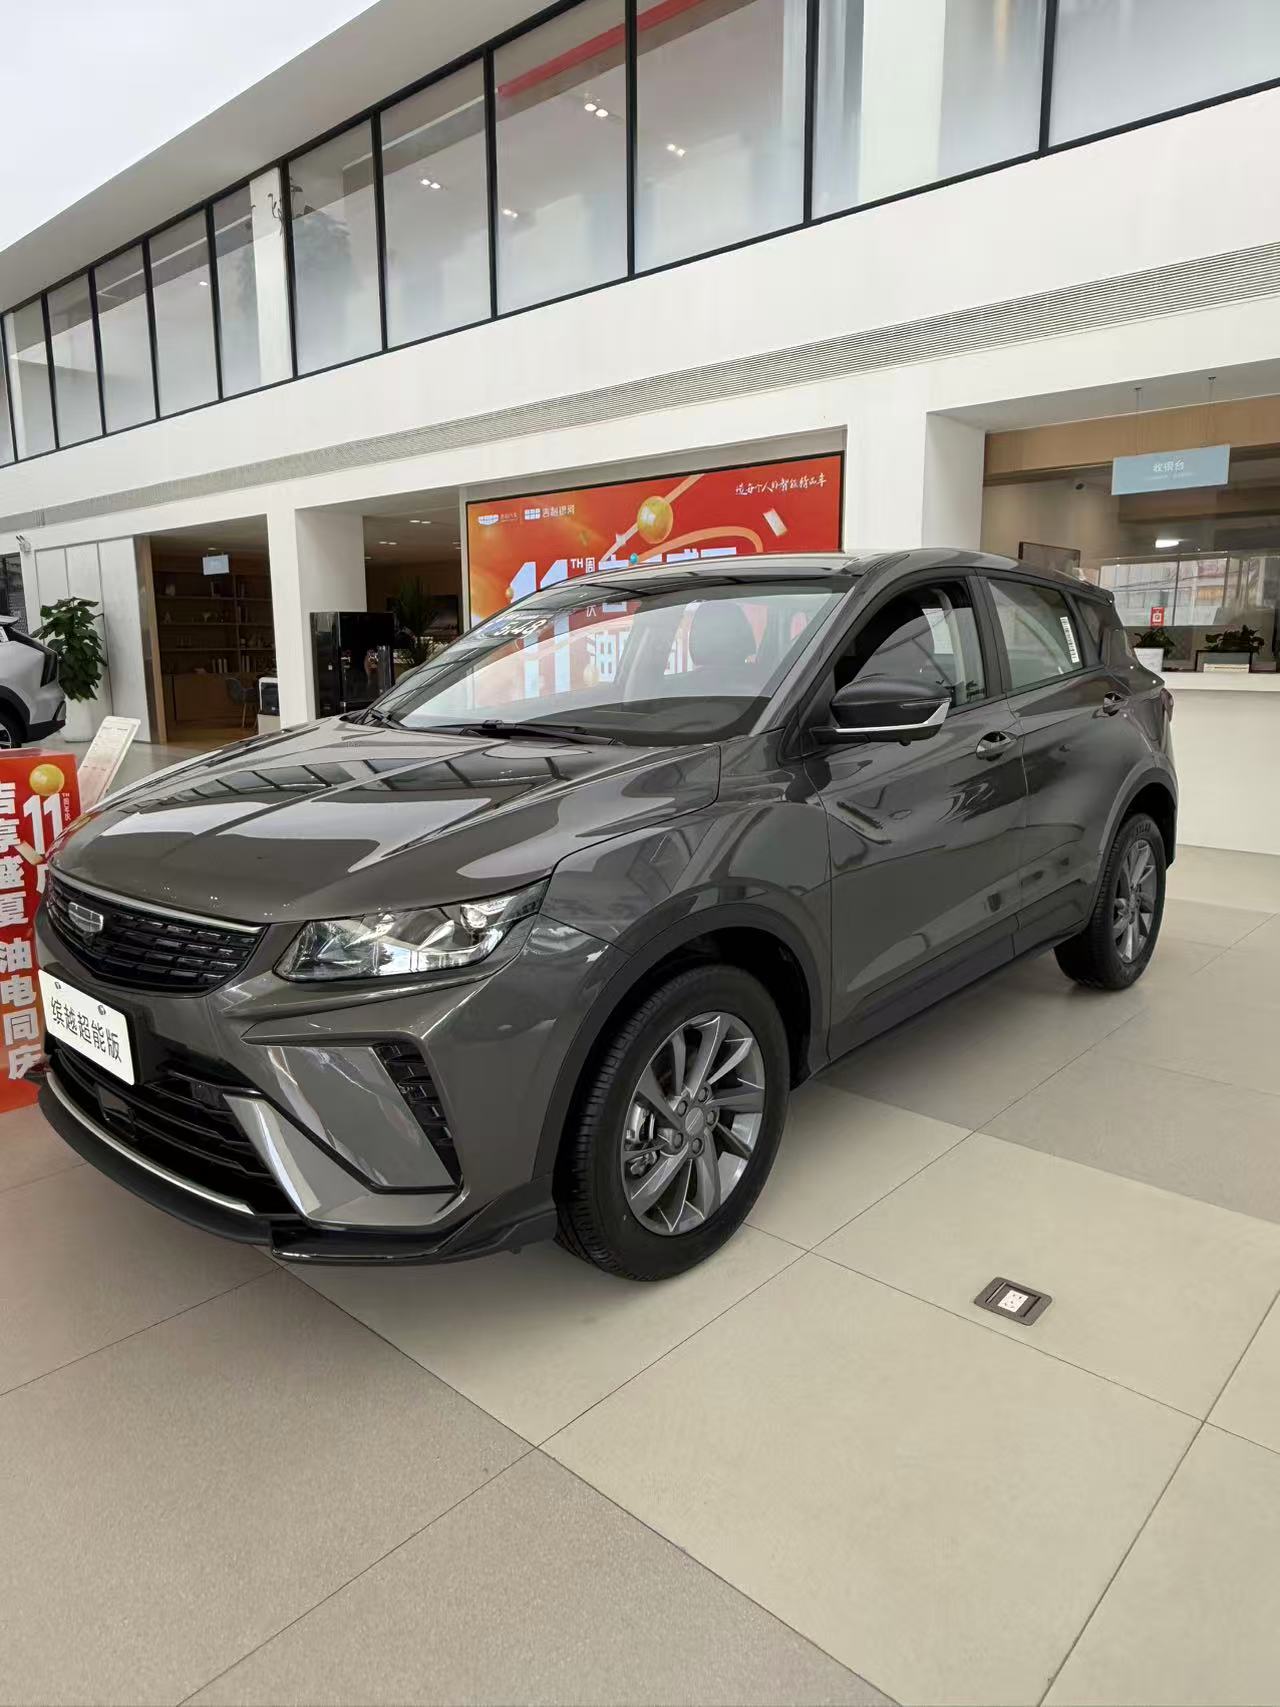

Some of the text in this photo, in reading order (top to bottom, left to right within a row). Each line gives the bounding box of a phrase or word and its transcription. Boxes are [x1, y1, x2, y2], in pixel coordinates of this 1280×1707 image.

[51, 996, 122, 1063] 缤越超能版
